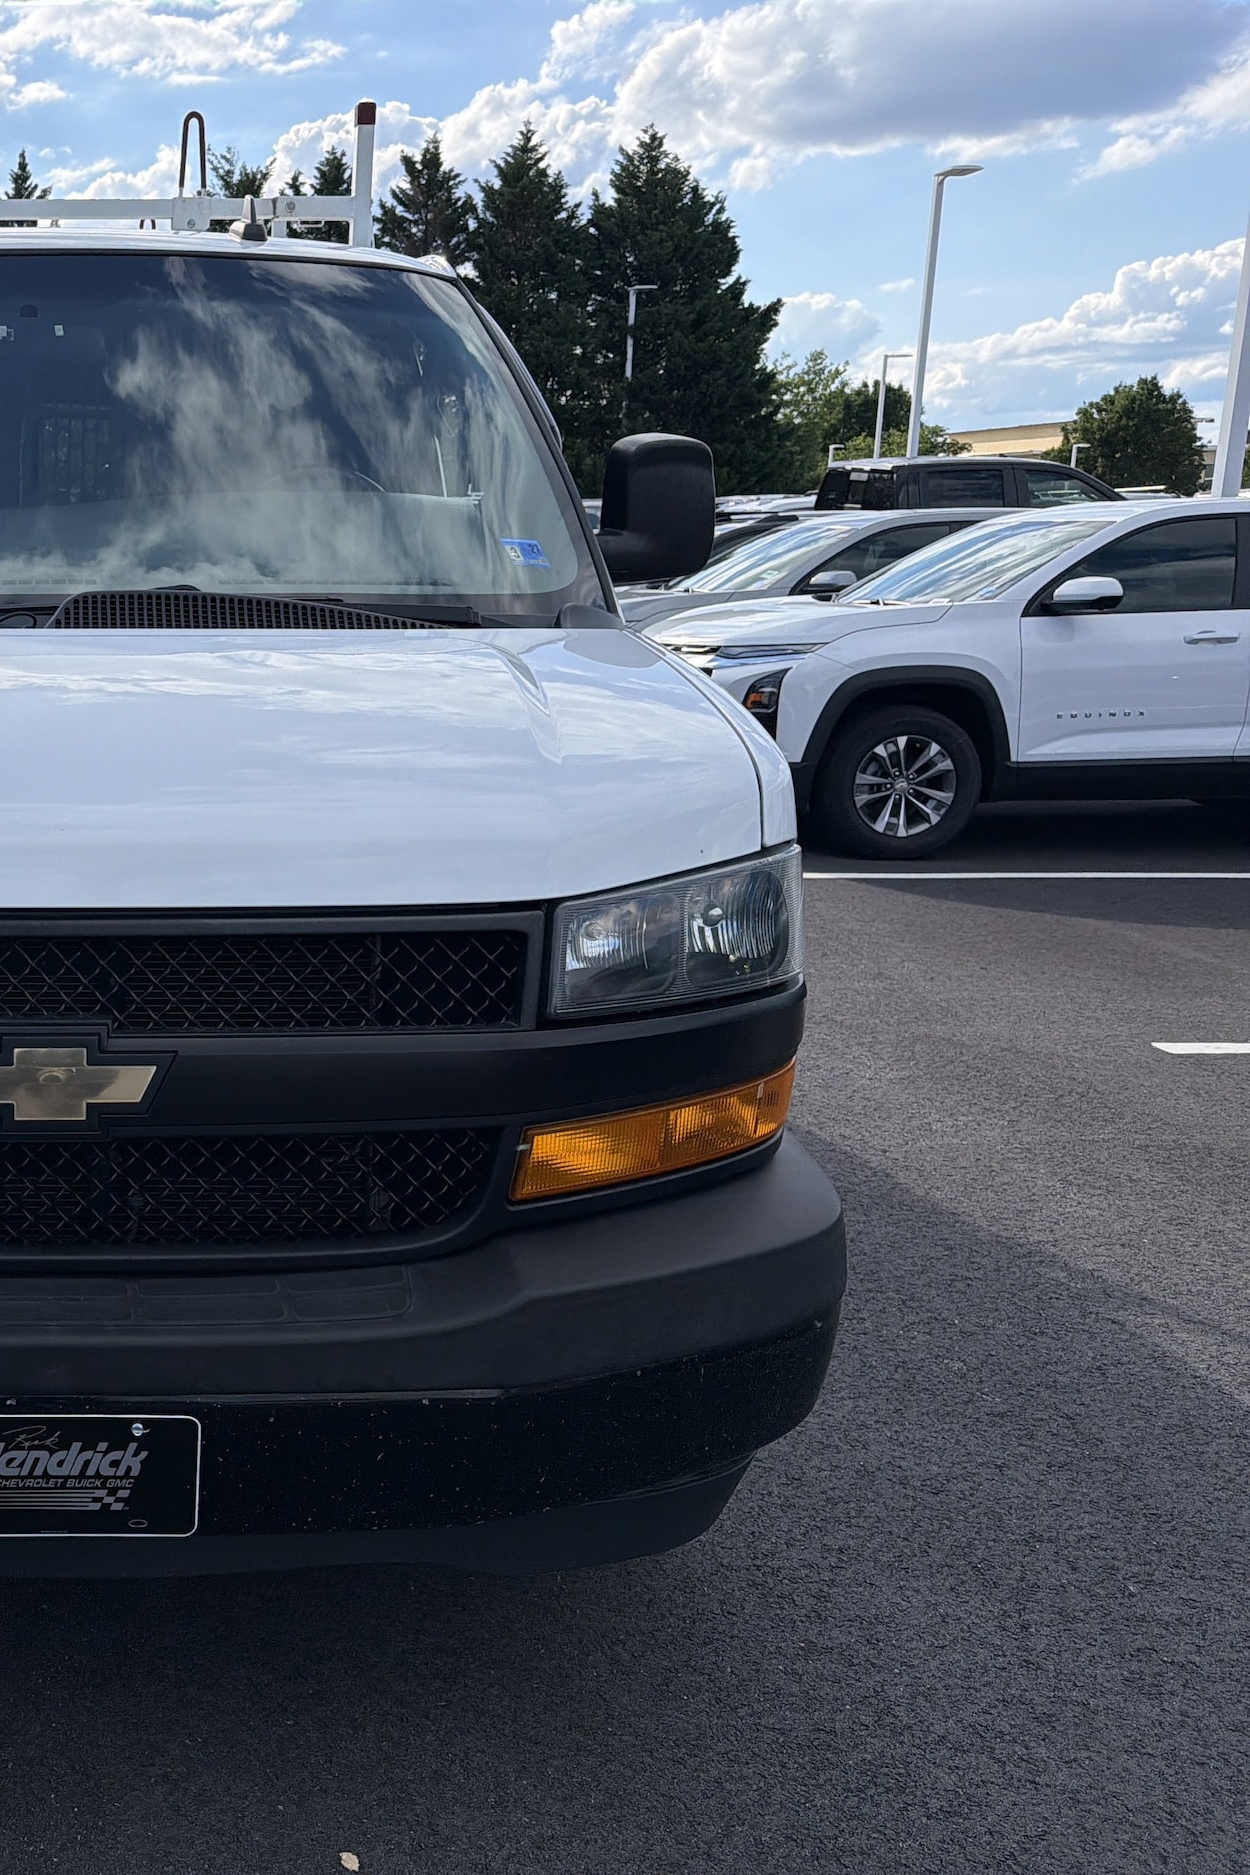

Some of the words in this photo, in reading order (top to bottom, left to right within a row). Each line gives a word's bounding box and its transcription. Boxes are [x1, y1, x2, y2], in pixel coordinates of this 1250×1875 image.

[1056, 709, 1146, 719] EQUINOX
[66, 1478, 104, 1488] BUICK
[106, 1478, 135, 1488] GMC
